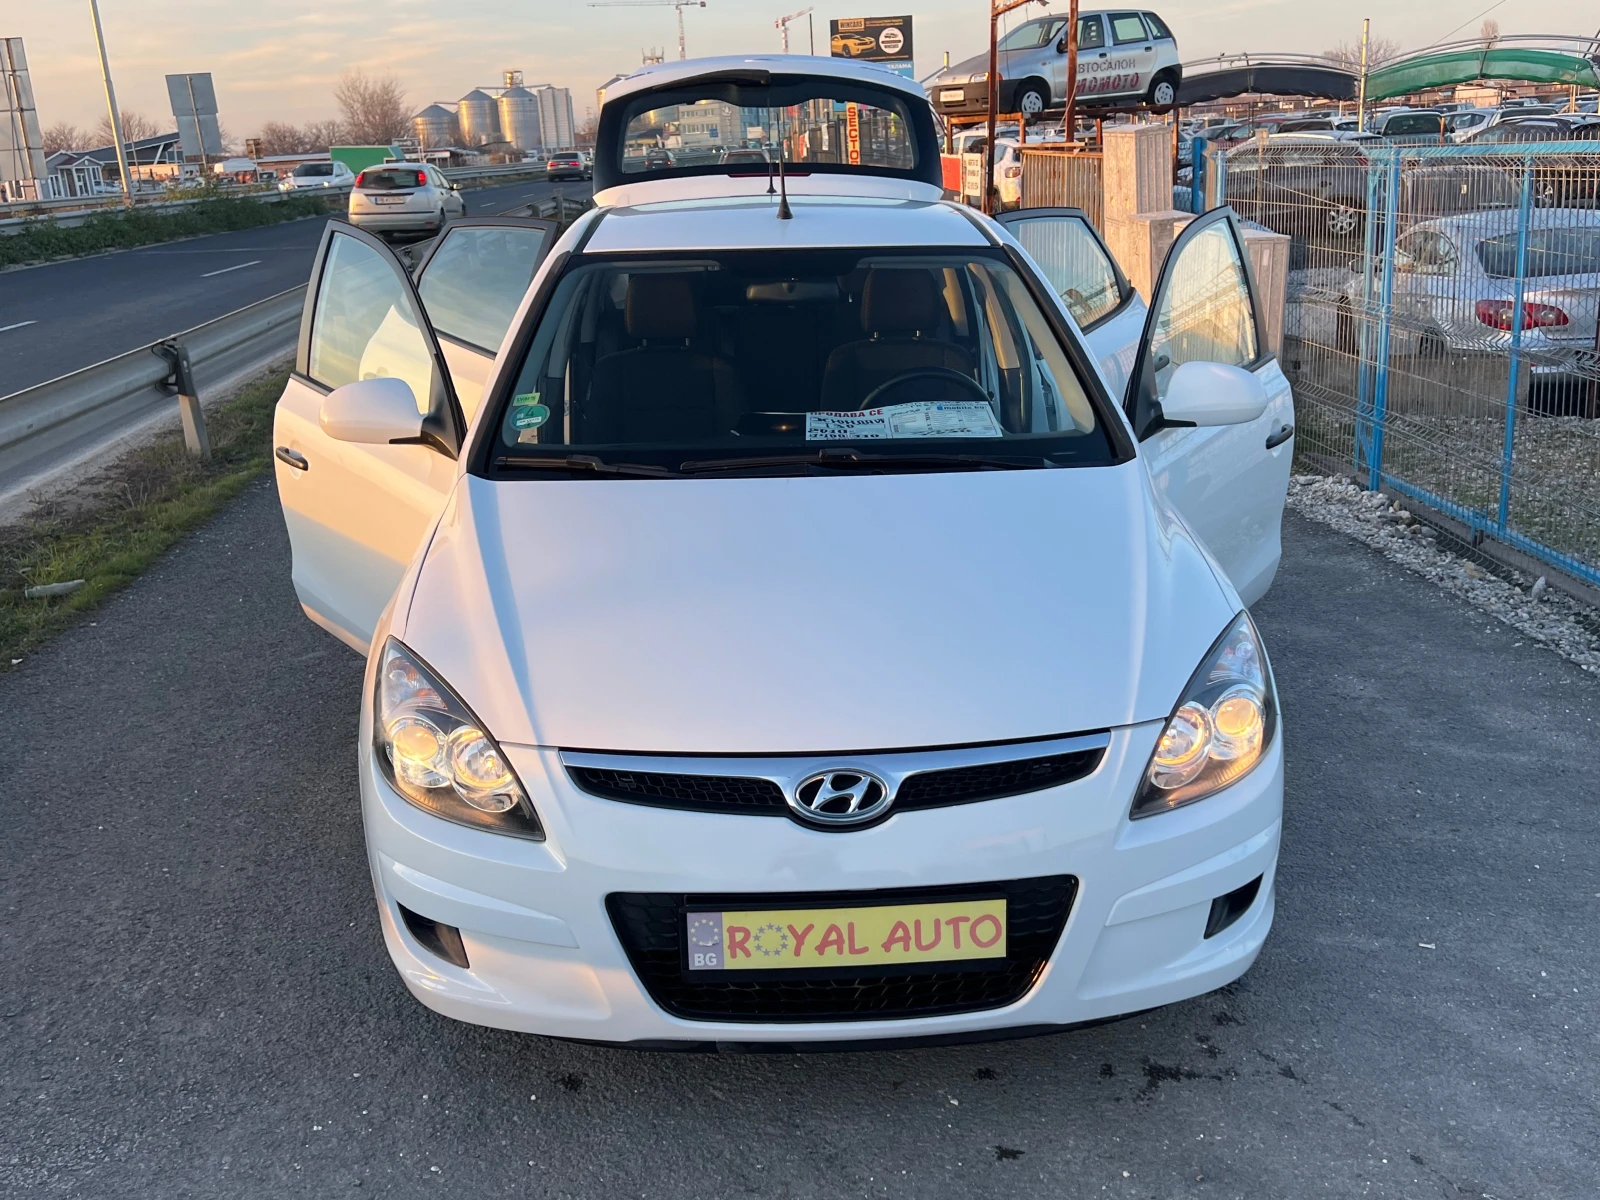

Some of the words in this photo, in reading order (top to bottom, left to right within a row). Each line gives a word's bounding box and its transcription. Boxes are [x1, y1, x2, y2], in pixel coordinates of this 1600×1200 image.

[1078, 59, 1136, 74] ВТОСАЛОН
[525, 407, 535, 417] 4
[881, 914, 1002, 953] AUTO
[694, 953, 717, 966] BG
